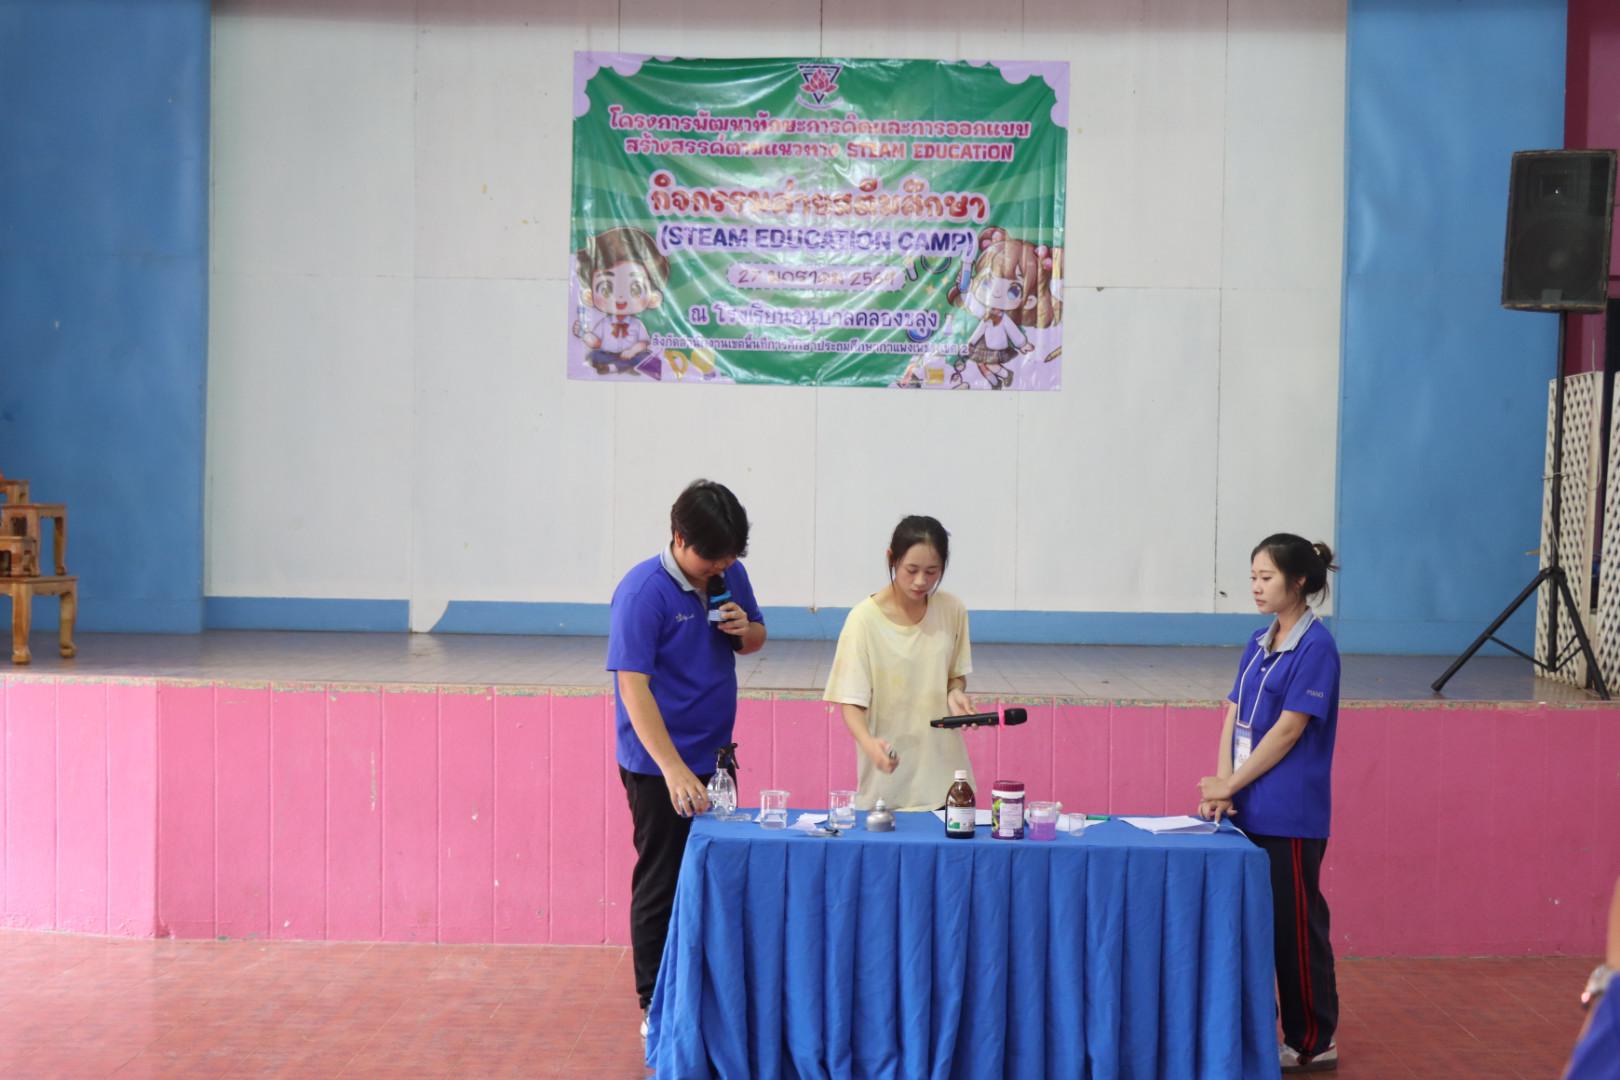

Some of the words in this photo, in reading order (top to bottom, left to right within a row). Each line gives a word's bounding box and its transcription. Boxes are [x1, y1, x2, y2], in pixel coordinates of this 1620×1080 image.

[847, 143, 904, 159] STEAM
[662, 225, 748, 250] (STEAM
[755, 228, 891, 250] EDUCATION
[897, 231, 973, 256] CAMP)
[738, 269, 761, 285] 27
[691, 307, 706, 322] ณ
